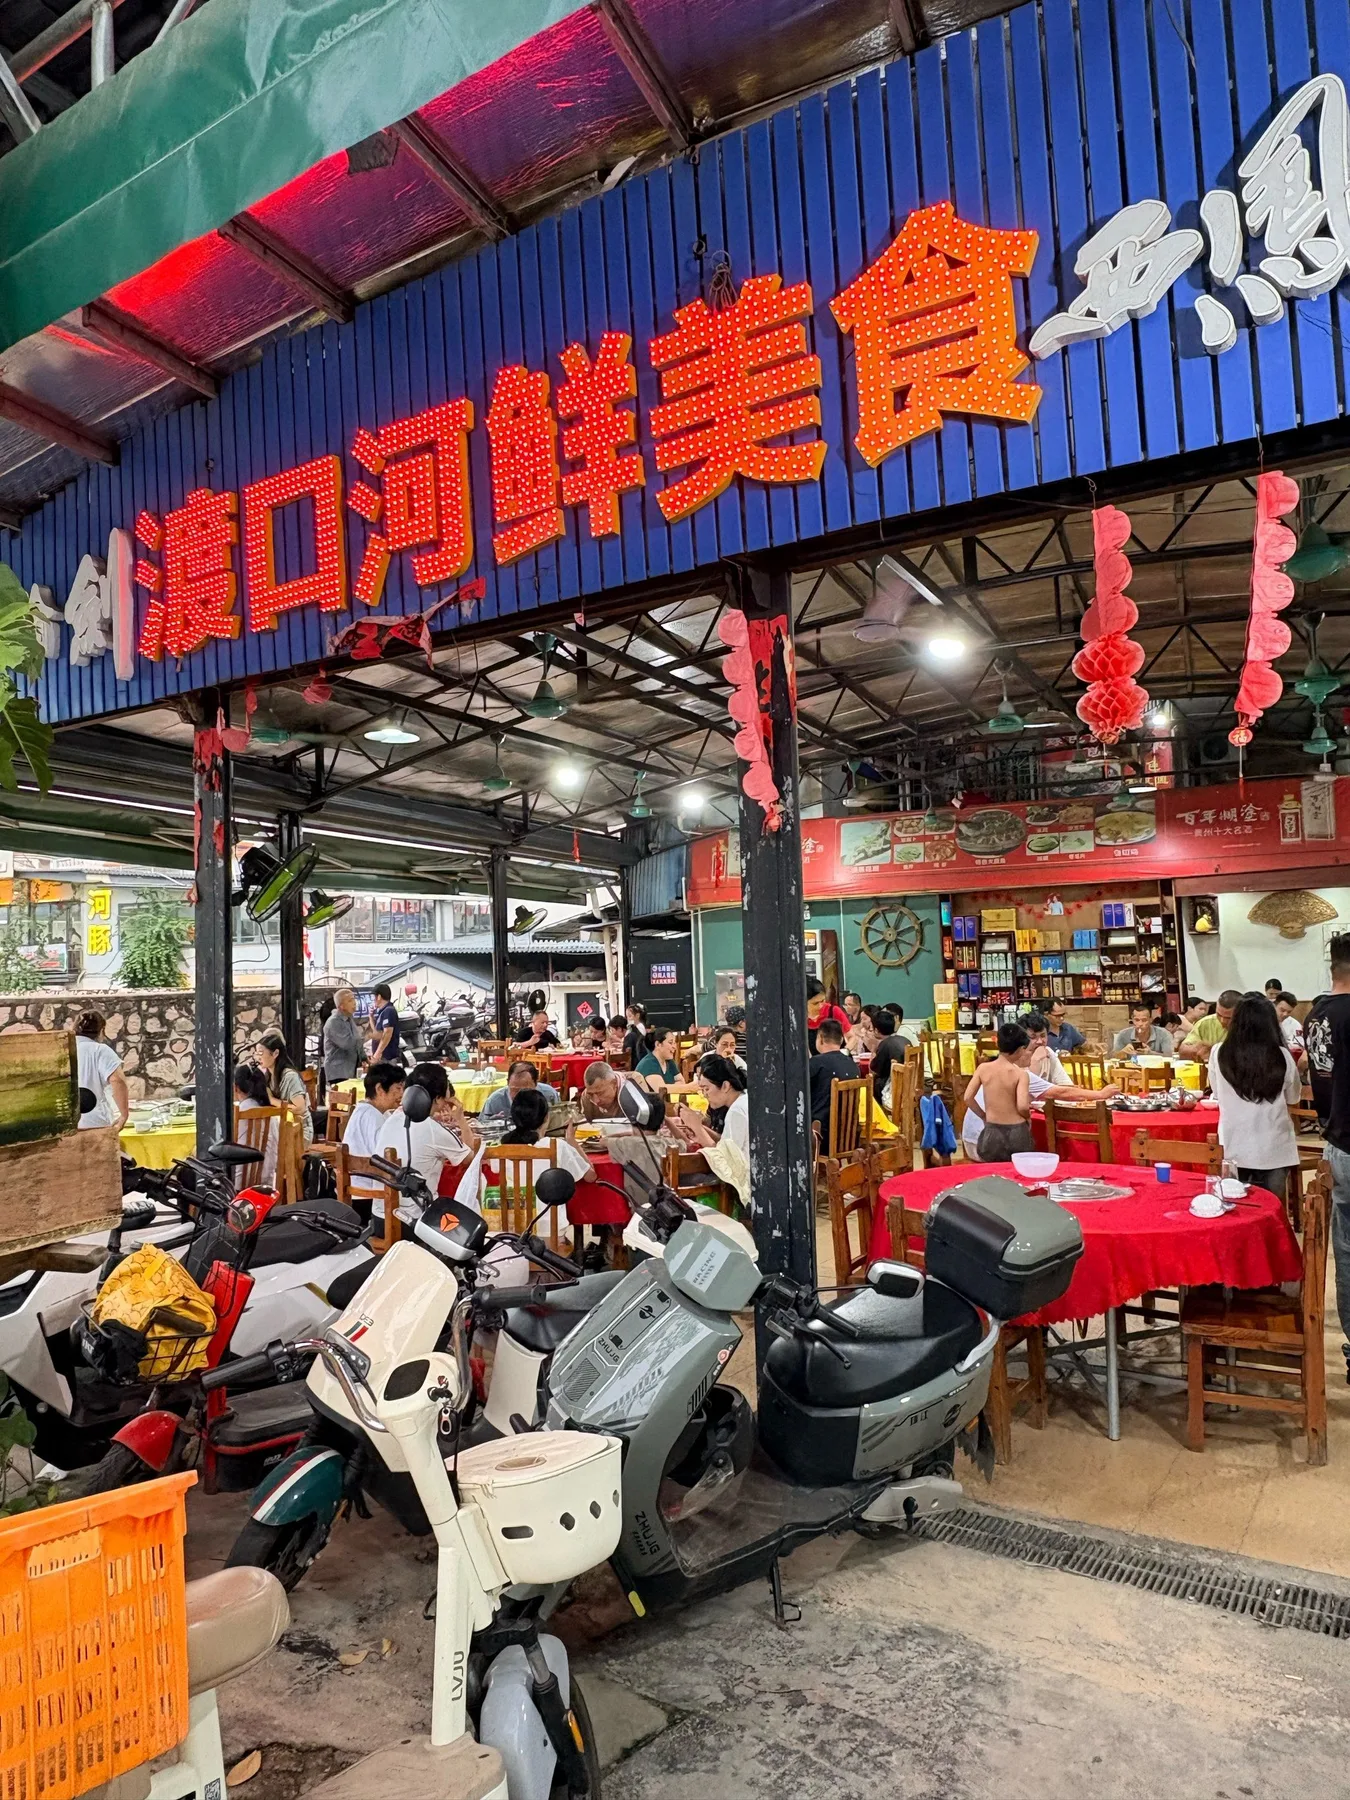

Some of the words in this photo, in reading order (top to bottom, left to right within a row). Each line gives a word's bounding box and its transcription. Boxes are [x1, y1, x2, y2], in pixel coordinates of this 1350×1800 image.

[134, 200, 1043, 662] 渡口河鲜美食
[86, 889, 113, 956] 河豚
[598, 1337, 620, 1363] ZHUJG
[634, 1510, 661, 1555] ZHUJG
[451, 1650, 465, 1701] LVJU
